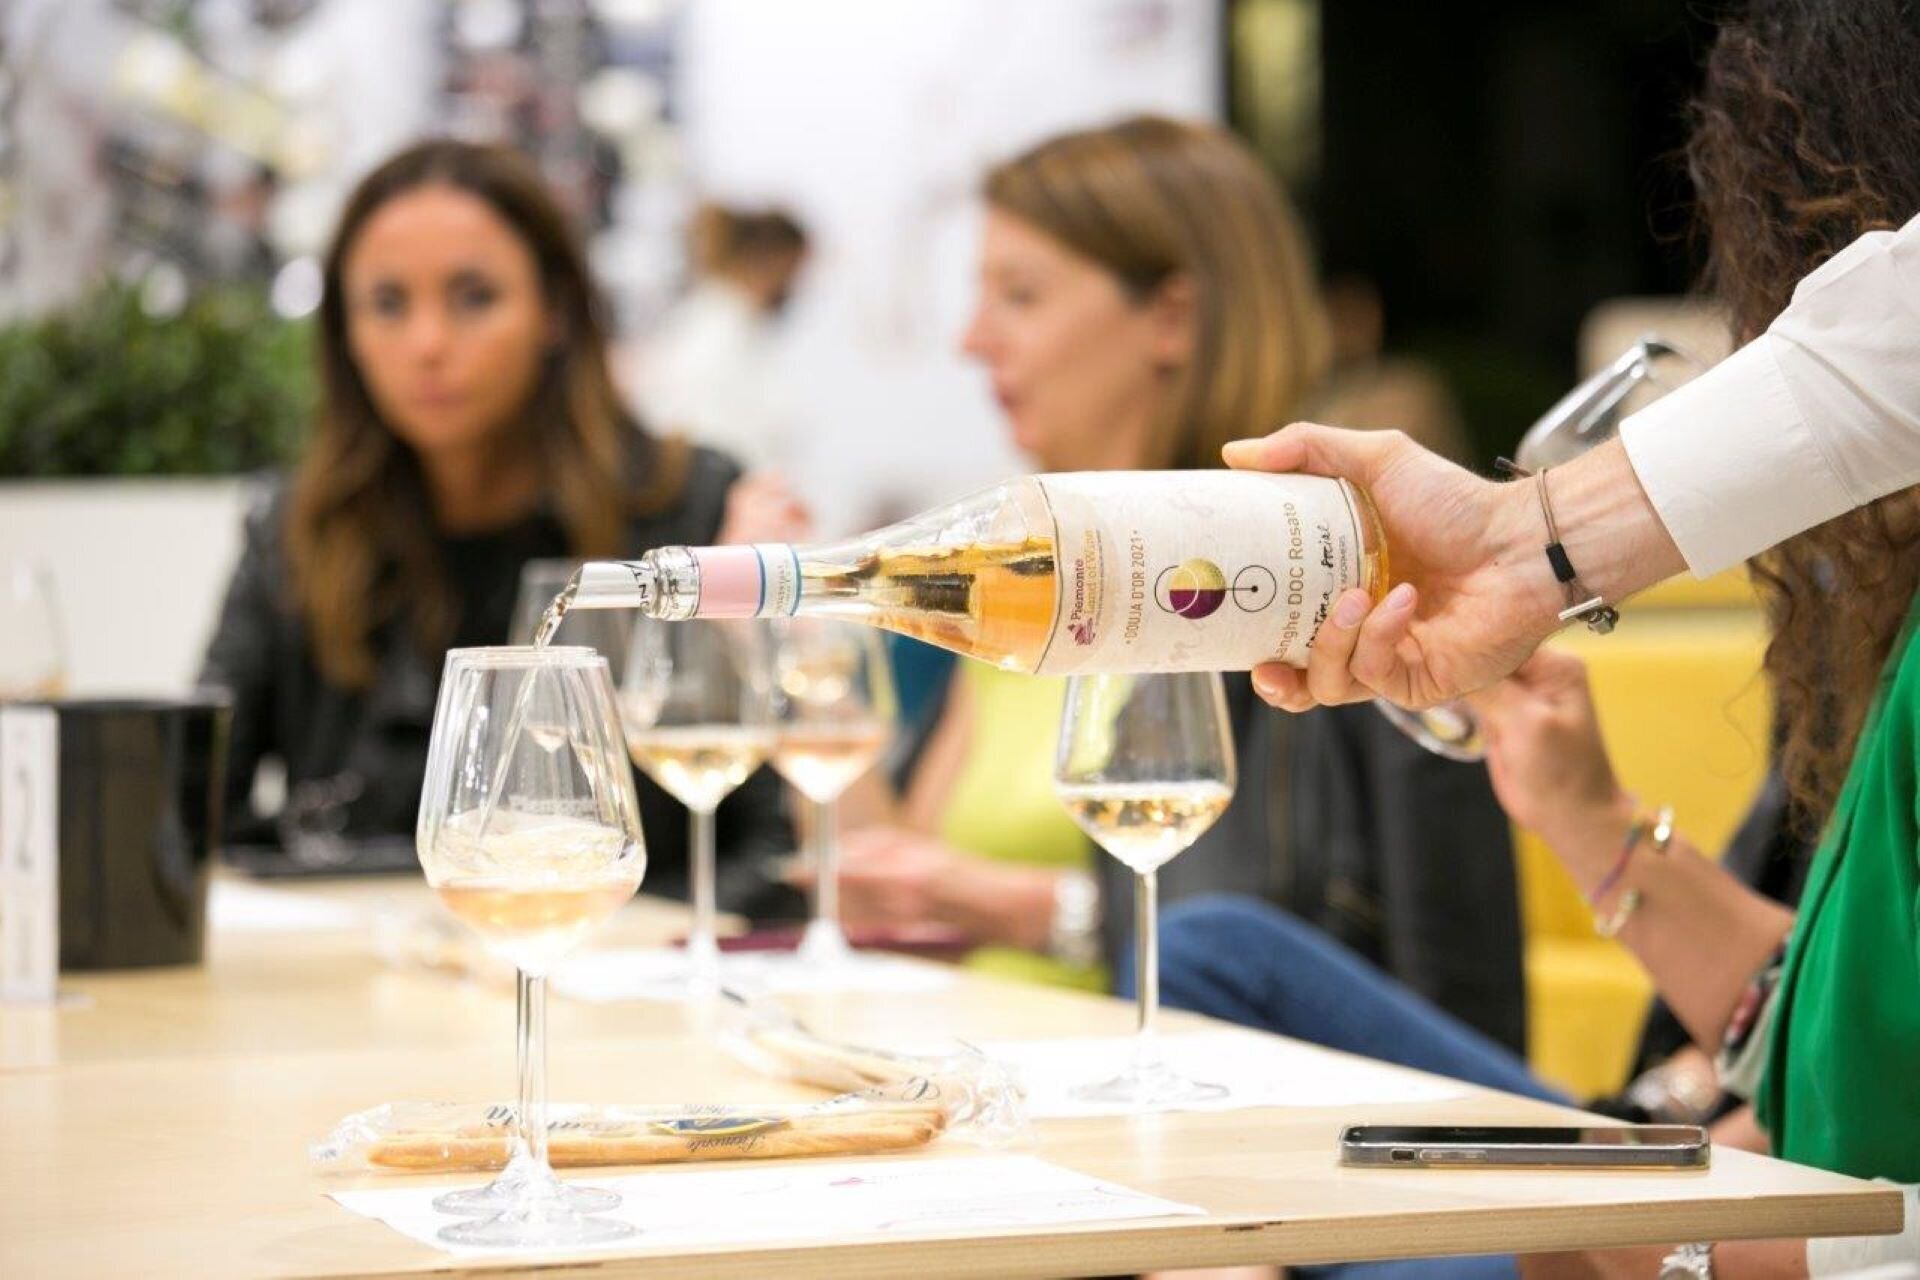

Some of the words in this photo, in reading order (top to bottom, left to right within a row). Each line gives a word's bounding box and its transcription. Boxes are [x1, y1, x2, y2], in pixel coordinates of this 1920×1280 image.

[1281, 501, 1304, 560] Rosato
[1130, 536, 1145, 568] 2021
[1069, 557, 1085, 621] Piemonte
[1083, 582, 1097, 615] Land
[1130, 570, 1145, 600] D'OR
[1286, 566, 1304, 605] DOC
[1124, 603, 1143, 639] DOUJA
